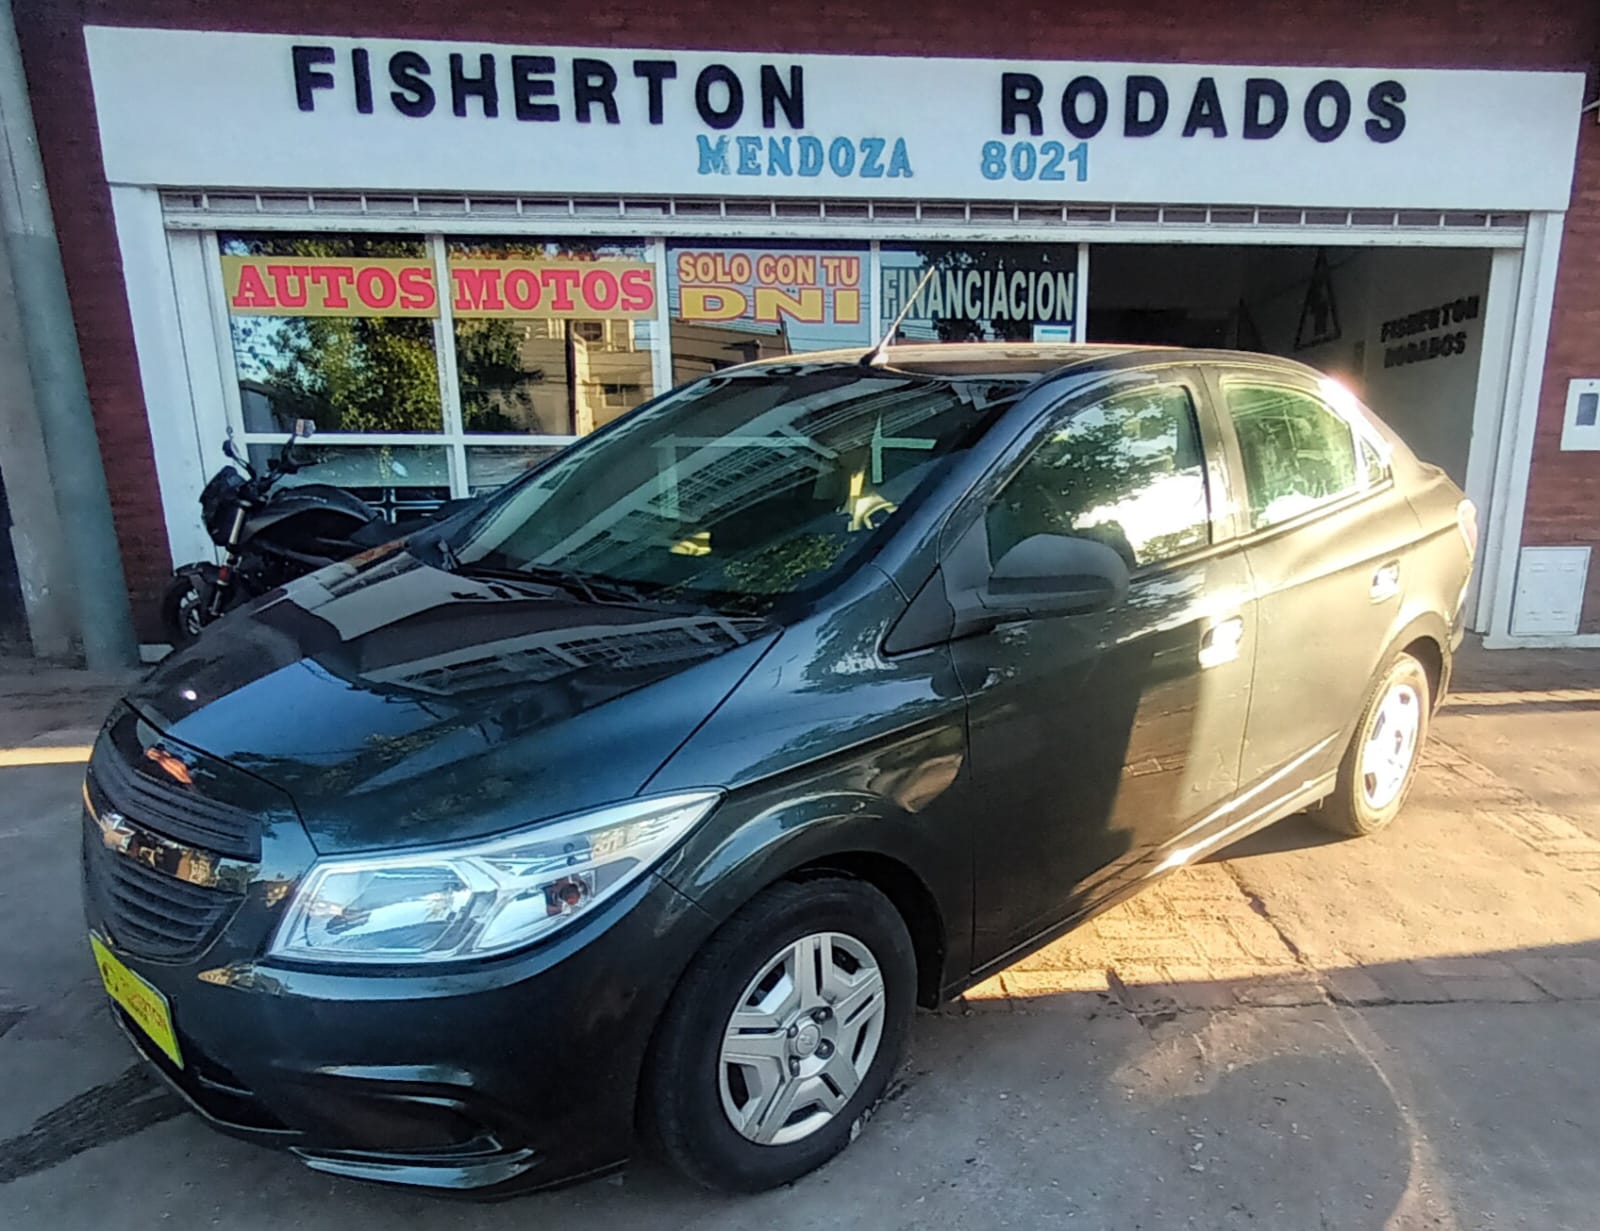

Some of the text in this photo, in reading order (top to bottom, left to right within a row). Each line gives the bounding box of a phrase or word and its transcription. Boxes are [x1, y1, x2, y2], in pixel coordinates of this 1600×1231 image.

[291, 45, 1407, 143] FISHERTON RODADOS
[696, 134, 1088, 182] MENDOZA 8021
[232, 264, 436, 309] AUTOS
[451, 268, 655, 311] MOTOS
[677, 252, 860, 287] SOLO CON TU
[679, 285, 860, 324] DNI
[882, 269, 1075, 321] FINANCIACION
